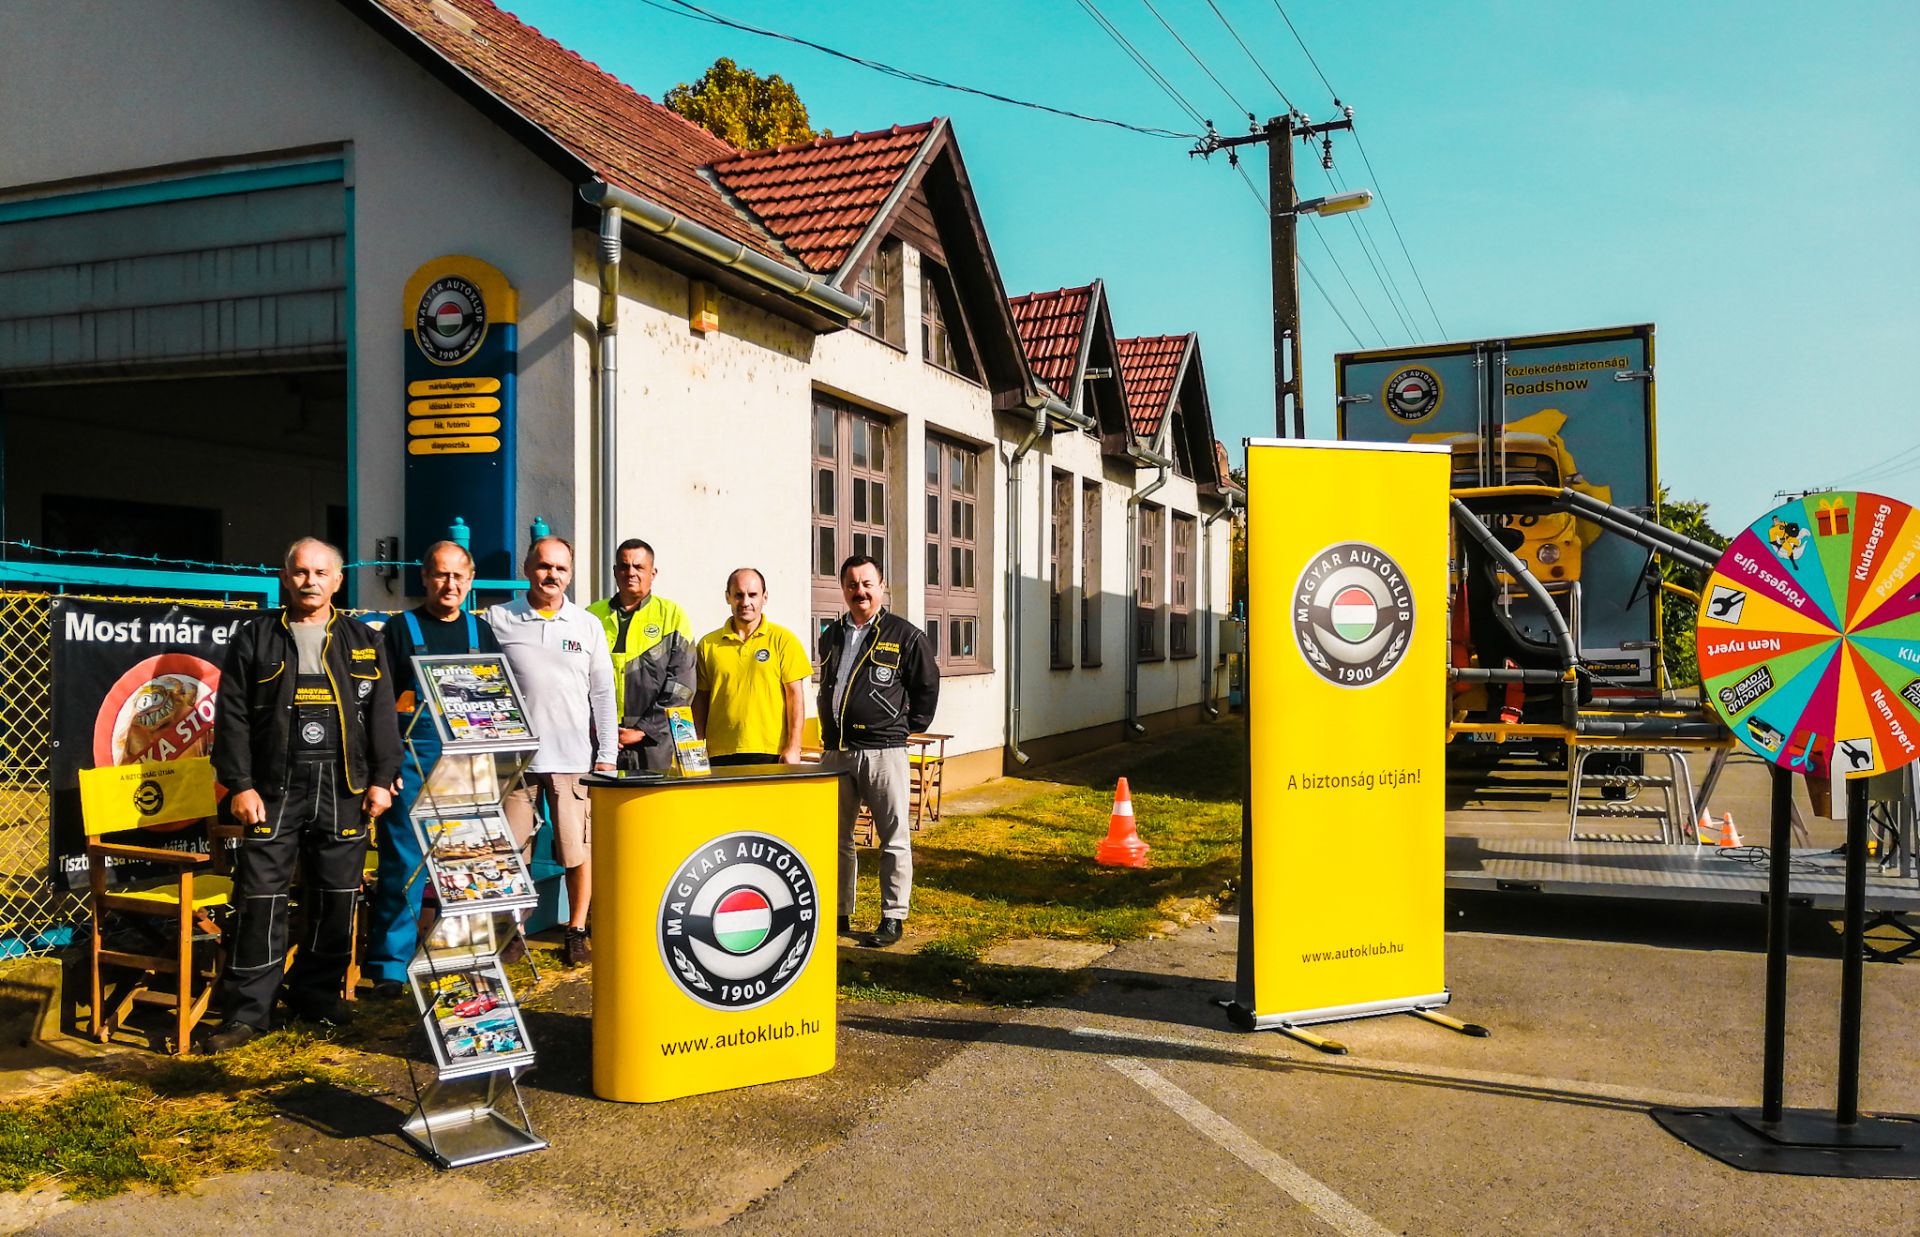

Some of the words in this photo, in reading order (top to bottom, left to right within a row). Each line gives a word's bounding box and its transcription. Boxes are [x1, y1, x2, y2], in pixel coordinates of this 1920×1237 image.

[418, 282, 443, 326] MAGYAR
[438, 350, 460, 359] 1900
[1504, 357, 1629, 377] Közlekedésbiztonsági
[1504, 378, 1589, 396] Roadshow
[1854, 504, 1892, 581] Klubtagság
[1733, 552, 1758, 574] újra
[1876, 550, 1916, 597] Pörgess
[1297, 552, 1343, 622] MAGYAR
[1350, 550, 1410, 621] AUTÓKLUB
[1758, 569, 1805, 609] Pörgess
[65, 612, 141, 643] Most
[149, 616, 206, 643] már
[1707, 640, 1745, 656] nyert
[1750, 638, 1781, 651] Nem
[1338, 666, 1373, 681] 1900
[1735, 668, 1766, 697] Travel
[444, 701, 497, 713] COOPER
[1728, 677, 1771, 713] Autoclub
[175, 692, 218, 744] STO
[1870, 688, 1894, 721] Nem
[1889, 719, 1916, 754] nyert
[1287, 774, 1298, 790] A
[1302, 770, 1375, 790] biztonság
[1379, 768, 1422, 789] útján!
[667, 848, 728, 936] MAGYAR
[736, 842, 813, 922] AUTÓKLUB
[1301, 941, 1405, 964] www.autoklub.hu
[720, 980, 767, 1001] 1900
[660, 1018, 821, 1057] www.autoklub.hu
